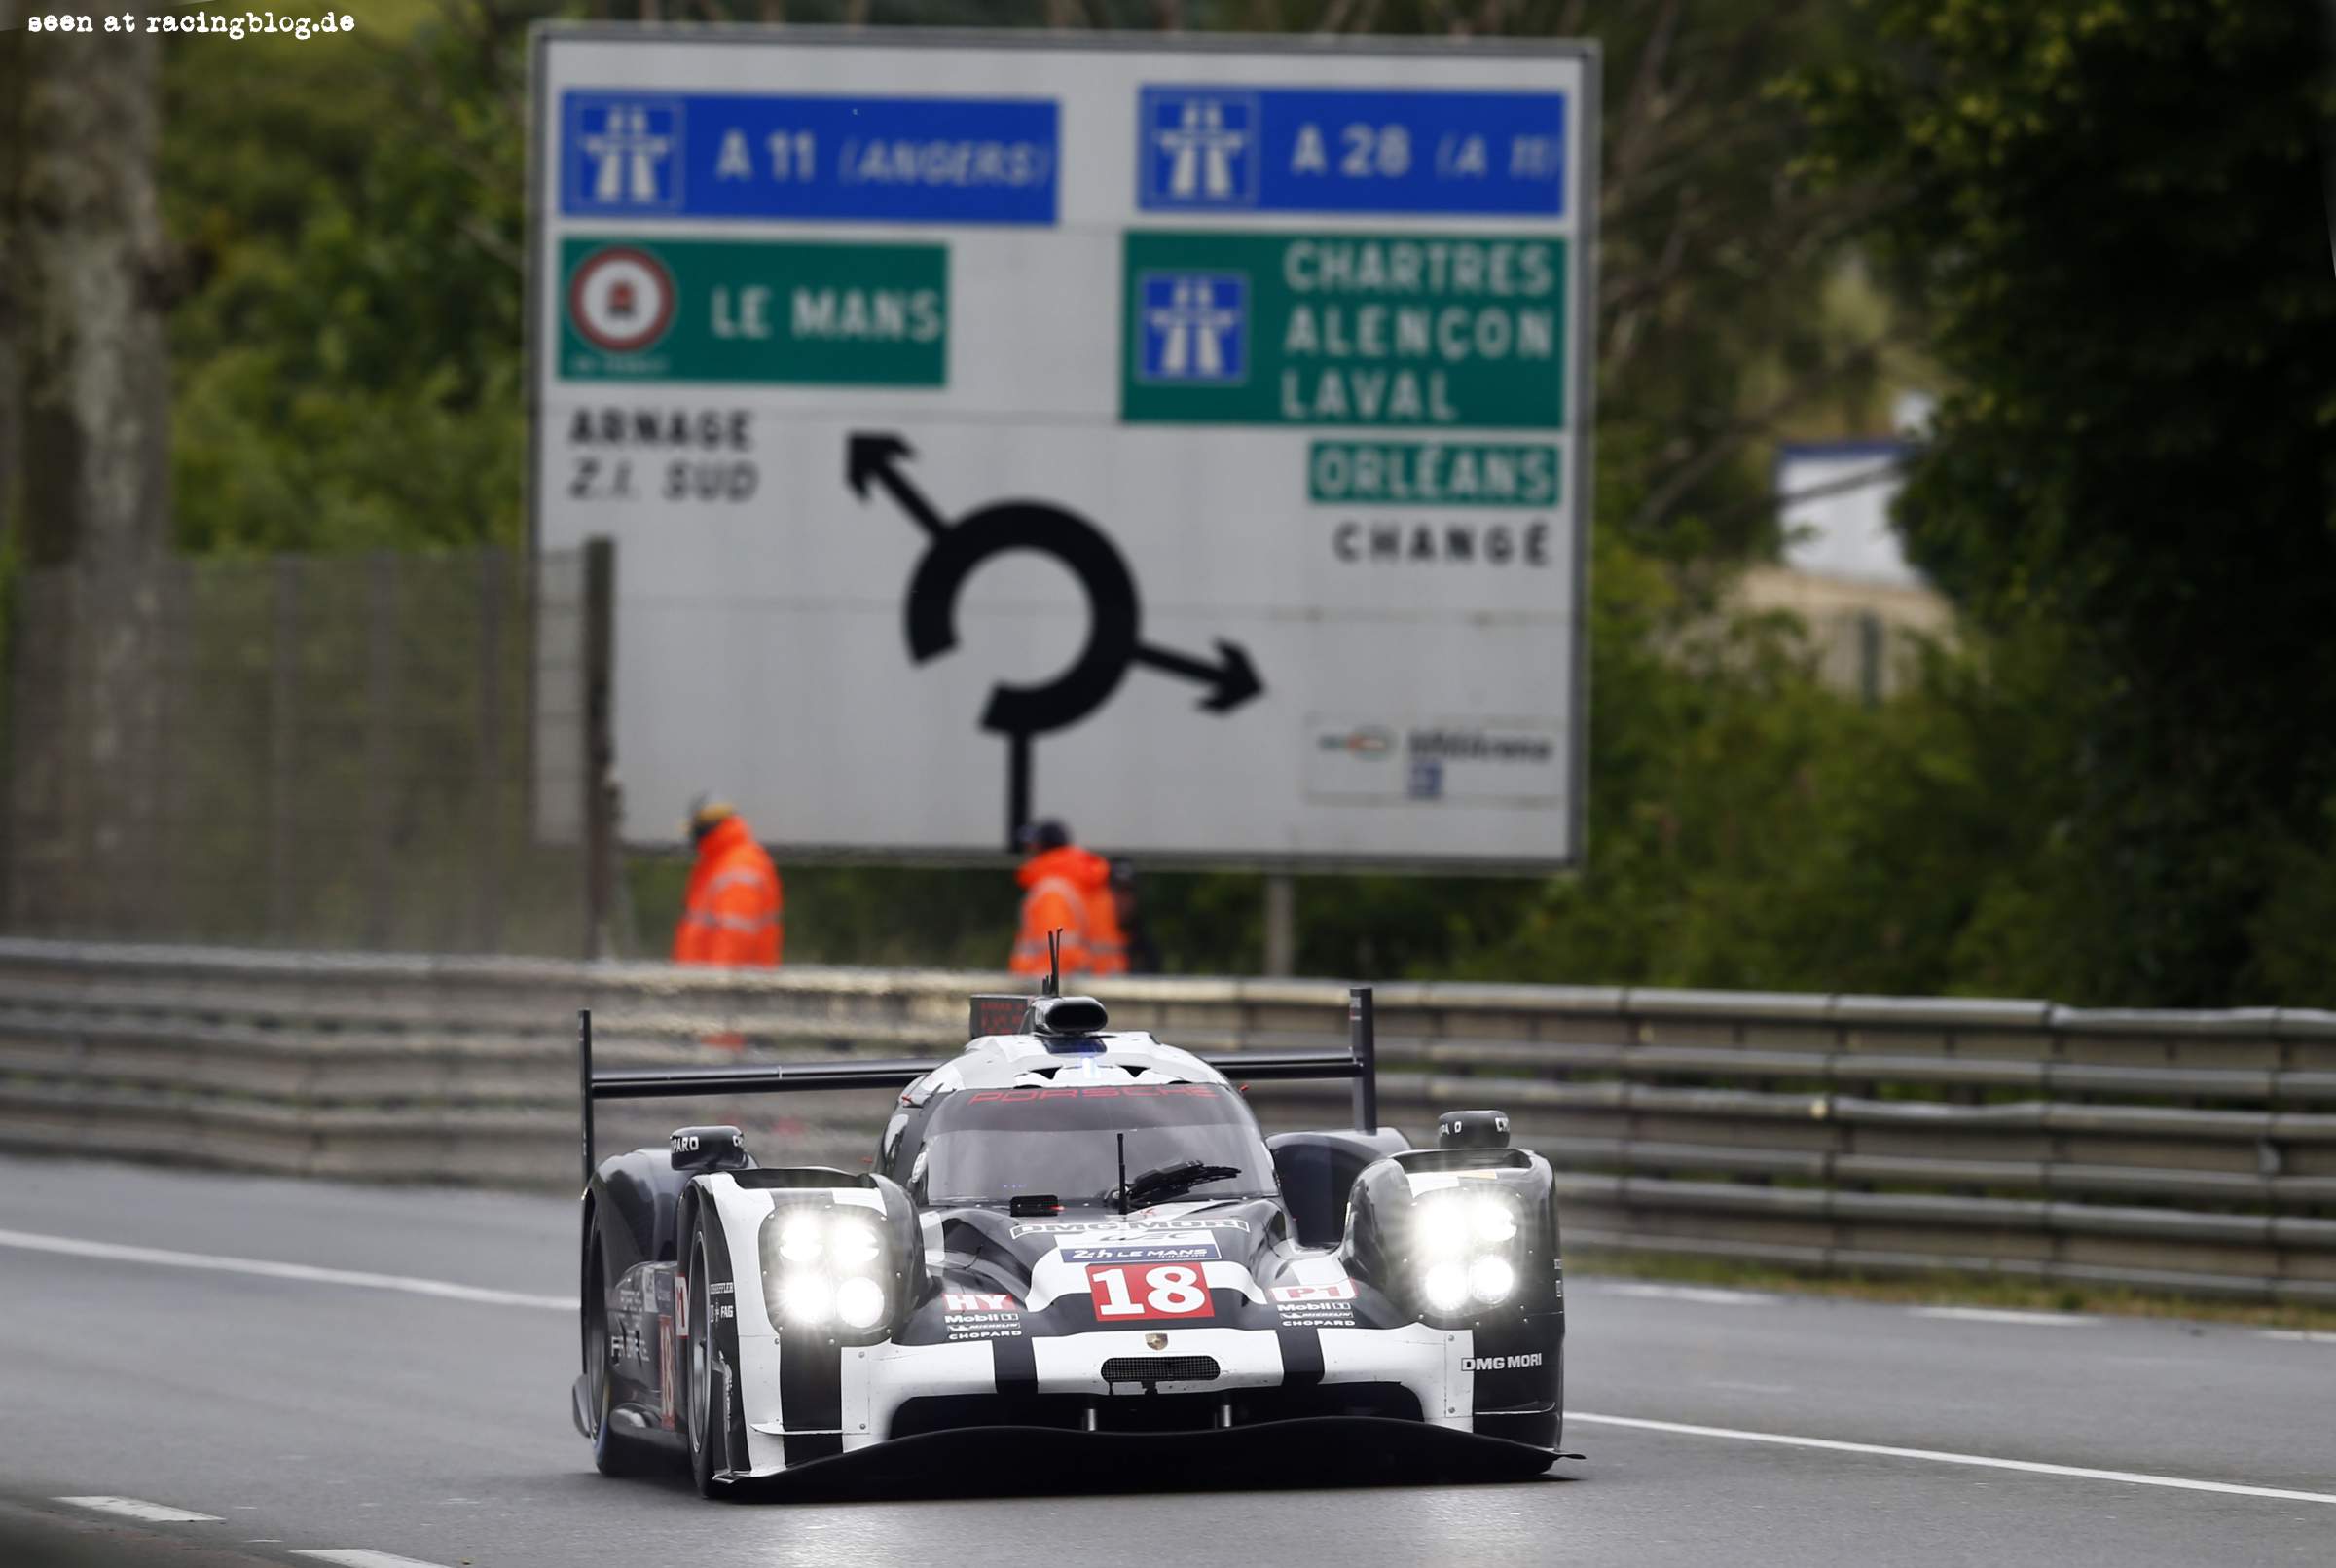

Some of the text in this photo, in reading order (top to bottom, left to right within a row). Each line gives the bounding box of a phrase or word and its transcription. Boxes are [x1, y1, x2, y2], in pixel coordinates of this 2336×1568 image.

[715, 128, 1052, 188] A 11 (ANGERS)
[1291, 123, 1327, 175] A
[1340, 123, 1411, 177] 28
[1282, 238, 1553, 297] CHARTRES
[712, 285, 945, 345] LE MANS
[1284, 303, 1554, 362] ALENÇON
[1281, 366, 1460, 421] LAVAL
[567, 405, 755, 454] ARNAGE
[661, 458, 760, 506] SUD
[1314, 440, 1553, 504] ORLÉANS
[1331, 521, 1551, 568] CHANGÉ
[969, 1086, 1218, 1104] PORSCHE
[944, 1294, 1007, 1311] HY
[1092, 1265, 1207, 1317] 18
[1276, 1302, 1332, 1312] Mobil
[1286, 1286, 1340, 1299] P1
[944, 1313, 999, 1324] Mobil
[948, 1330, 1022, 1340] CHOPARD
[1462, 1352, 1543, 1371] DMG MORI
